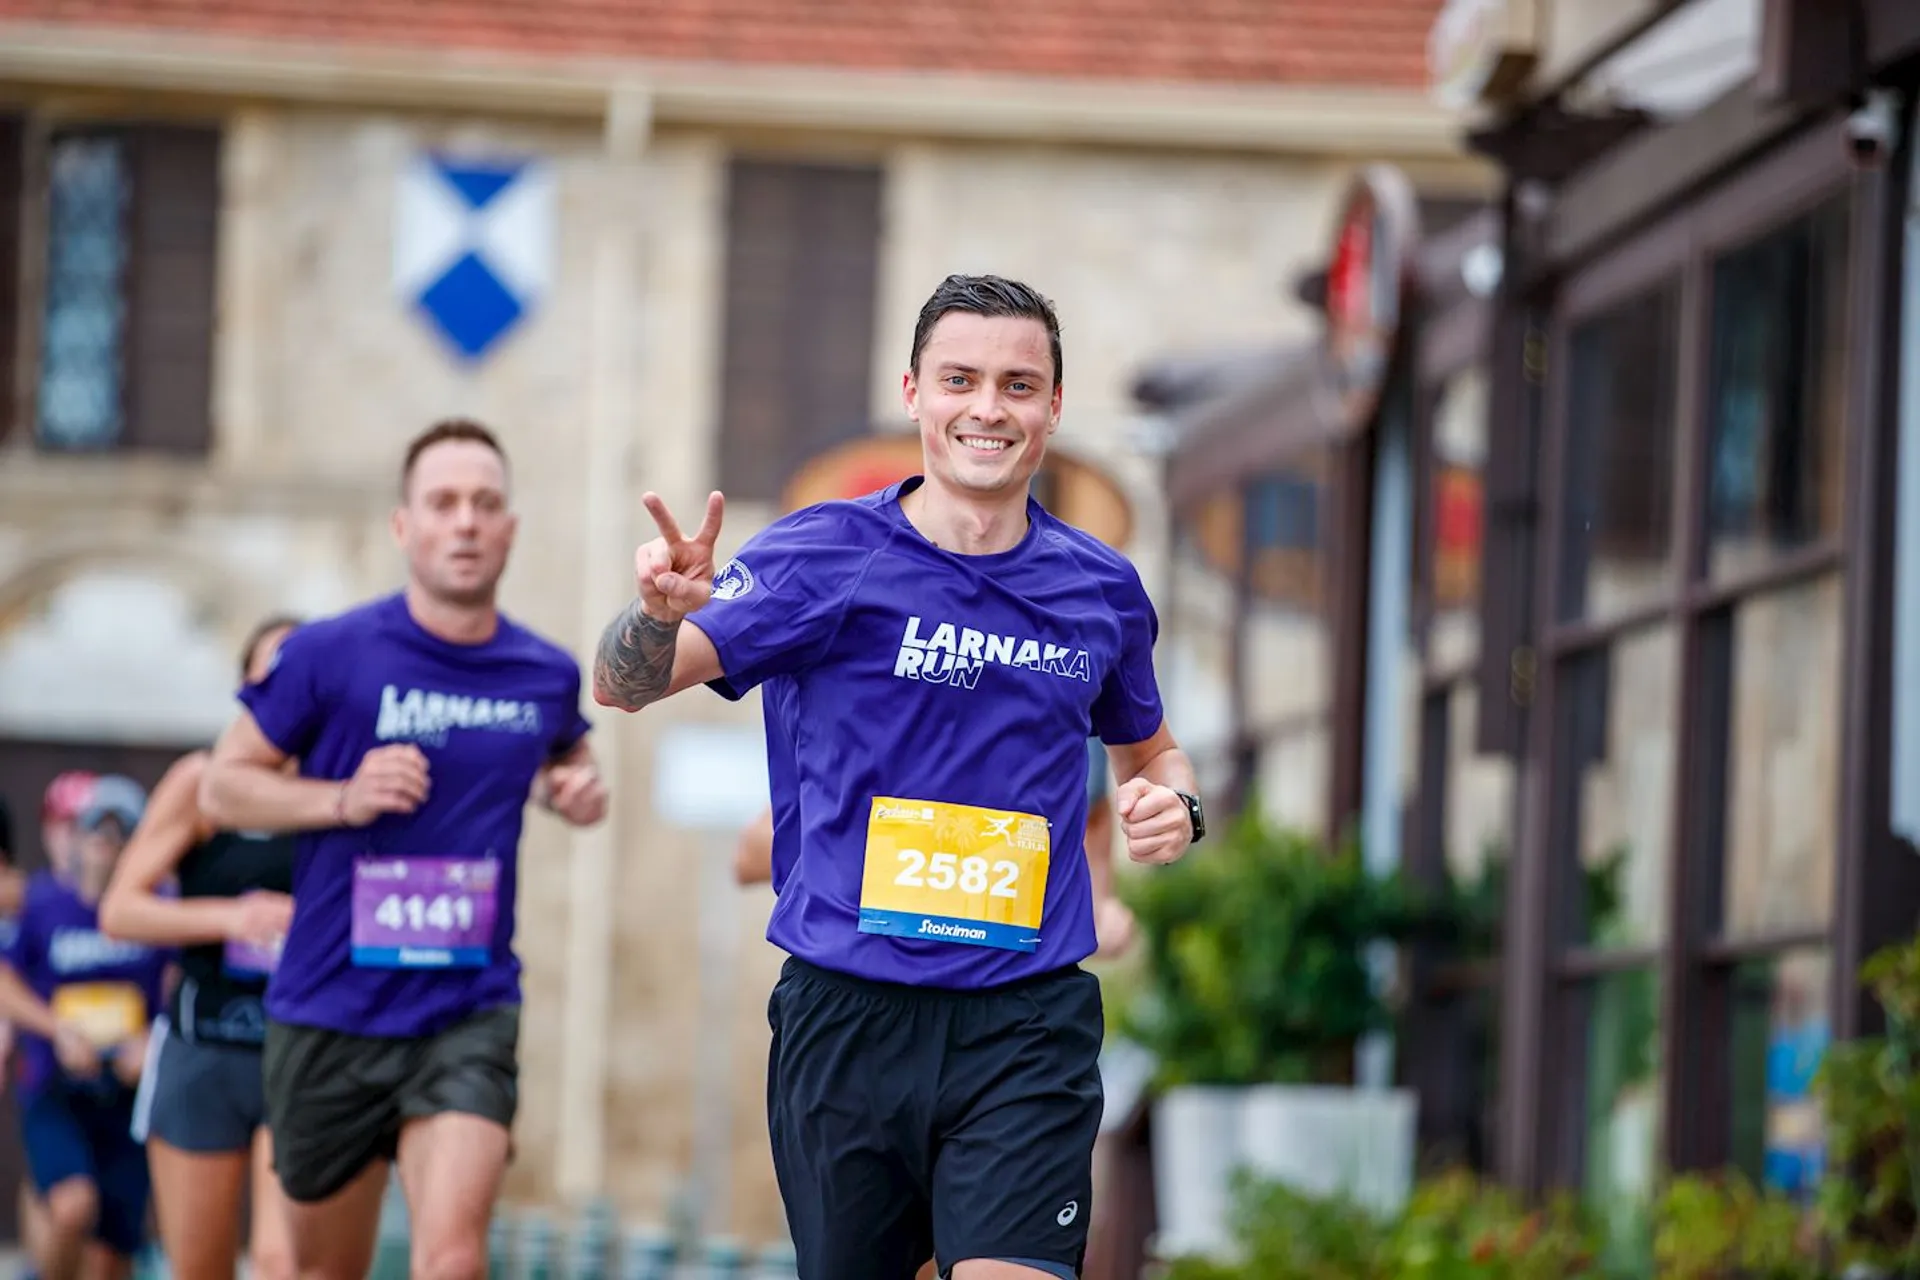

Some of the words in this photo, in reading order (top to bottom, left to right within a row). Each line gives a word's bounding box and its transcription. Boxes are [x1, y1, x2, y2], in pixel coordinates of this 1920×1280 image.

[893, 646, 985, 690] RUN
[901, 616, 1090, 682] LARNAKA
[894, 848, 1020, 898] 2582
[374, 893, 474, 932] 4141
[918, 919, 987, 940] Stoiximan
